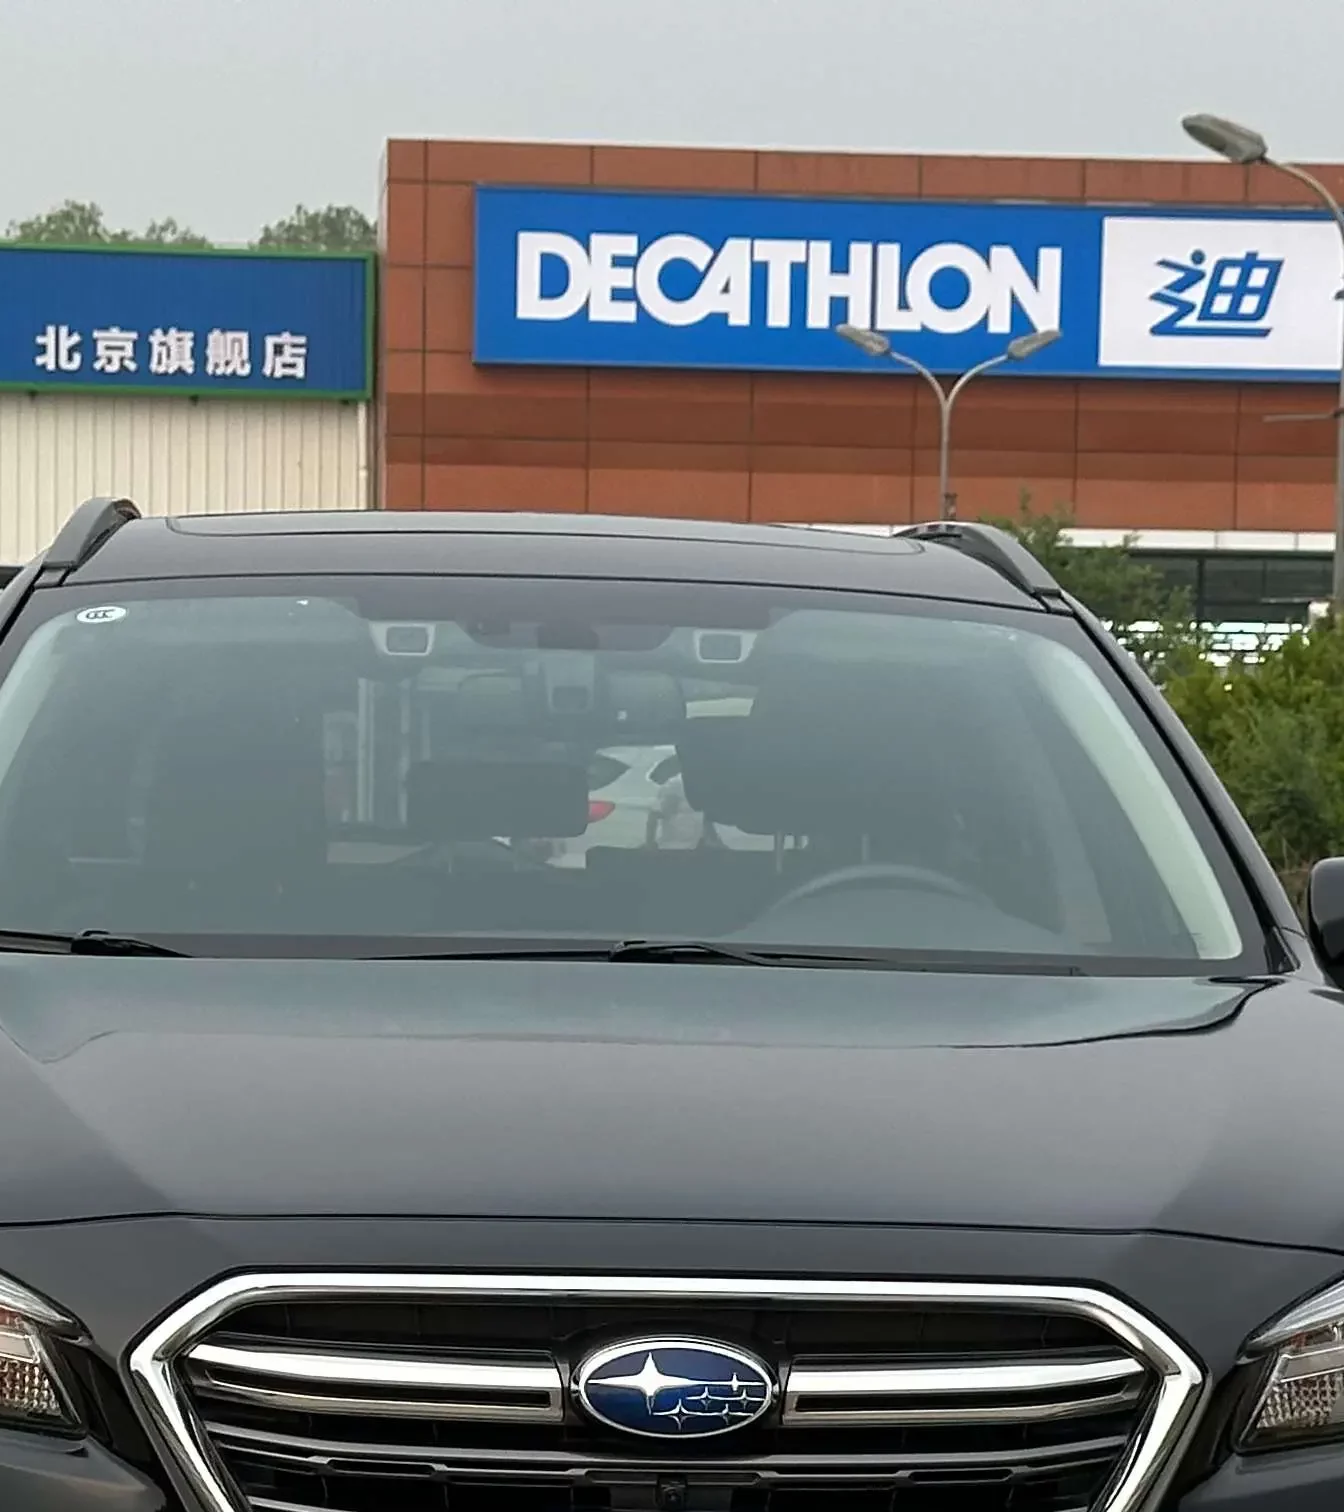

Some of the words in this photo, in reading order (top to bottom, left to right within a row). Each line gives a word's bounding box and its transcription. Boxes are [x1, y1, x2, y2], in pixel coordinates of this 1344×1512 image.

[515, 230, 1063, 337] DECATHLON
[35, 324, 308, 380] 北京旗舰店
